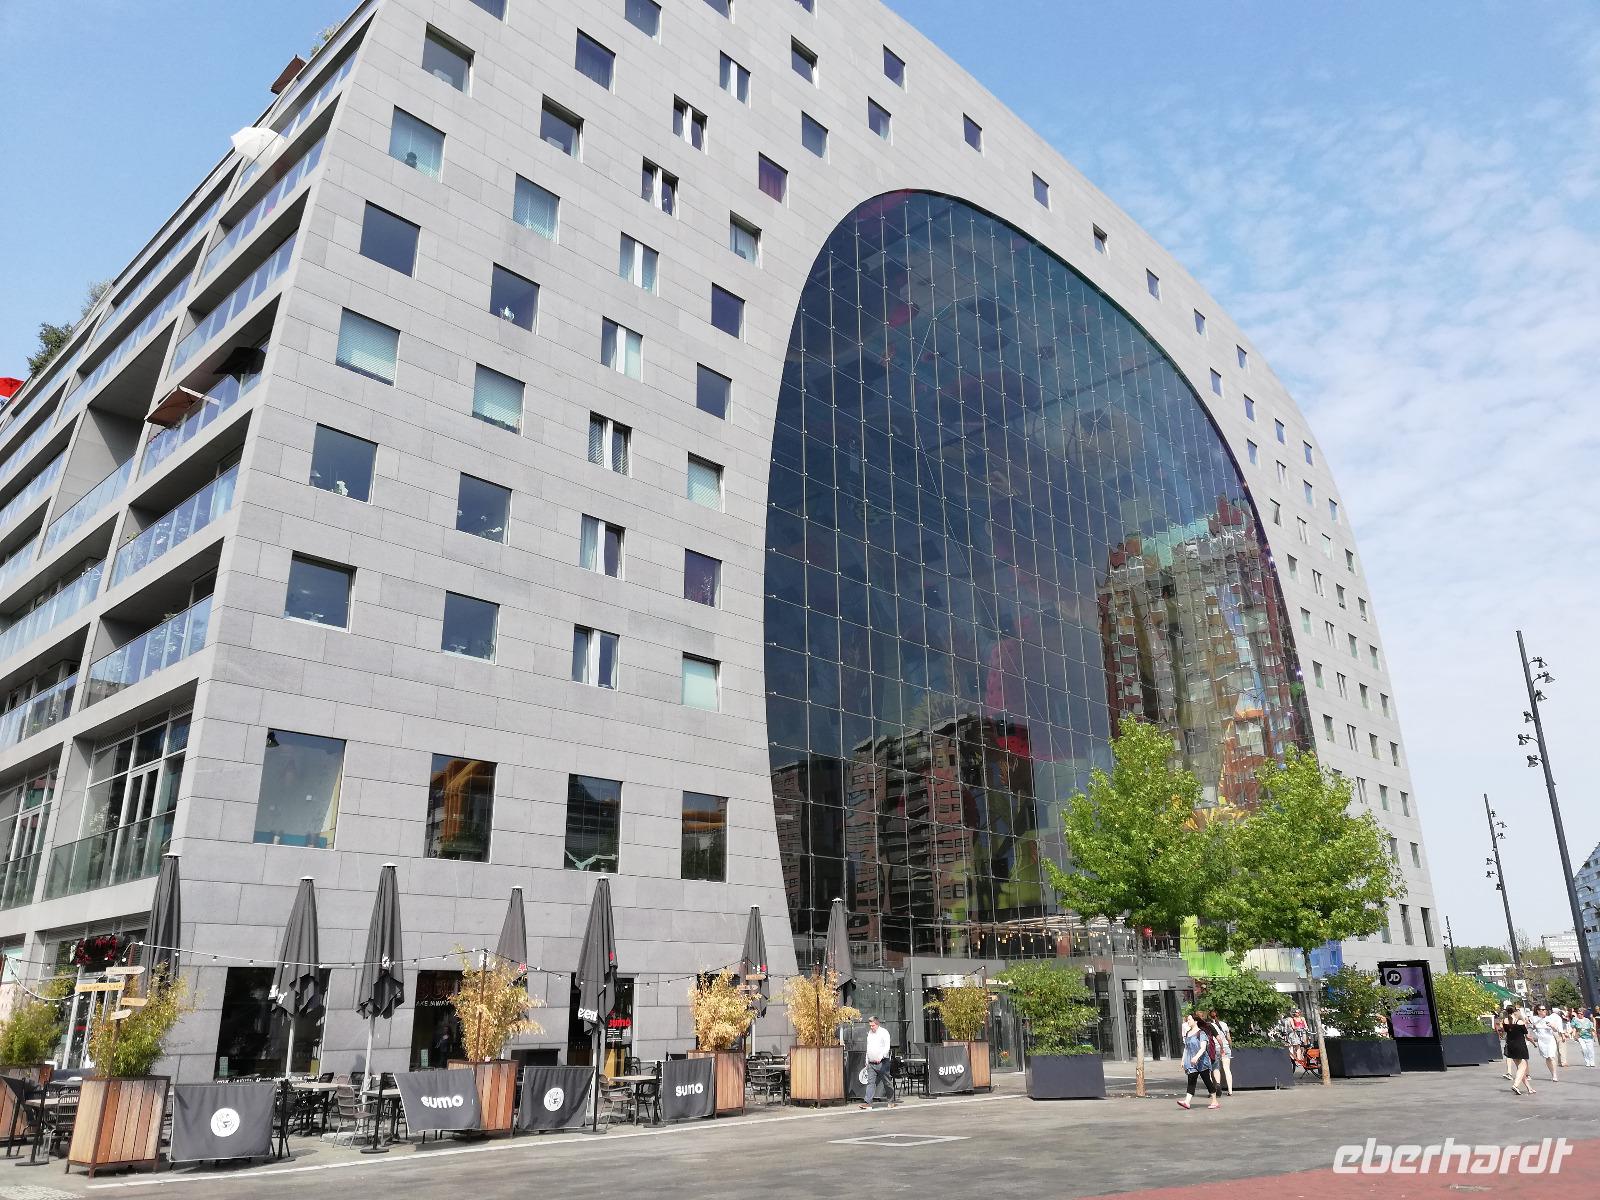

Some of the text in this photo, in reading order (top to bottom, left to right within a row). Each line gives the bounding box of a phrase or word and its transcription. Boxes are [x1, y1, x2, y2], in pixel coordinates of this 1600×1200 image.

[1388, 973, 1401, 983] JD
[608, 1018, 632, 1028] sumo
[939, 1063, 965, 1076] sumo
[675, 1082, 704, 1097] sumo
[420, 1093, 465, 1110] sumo
